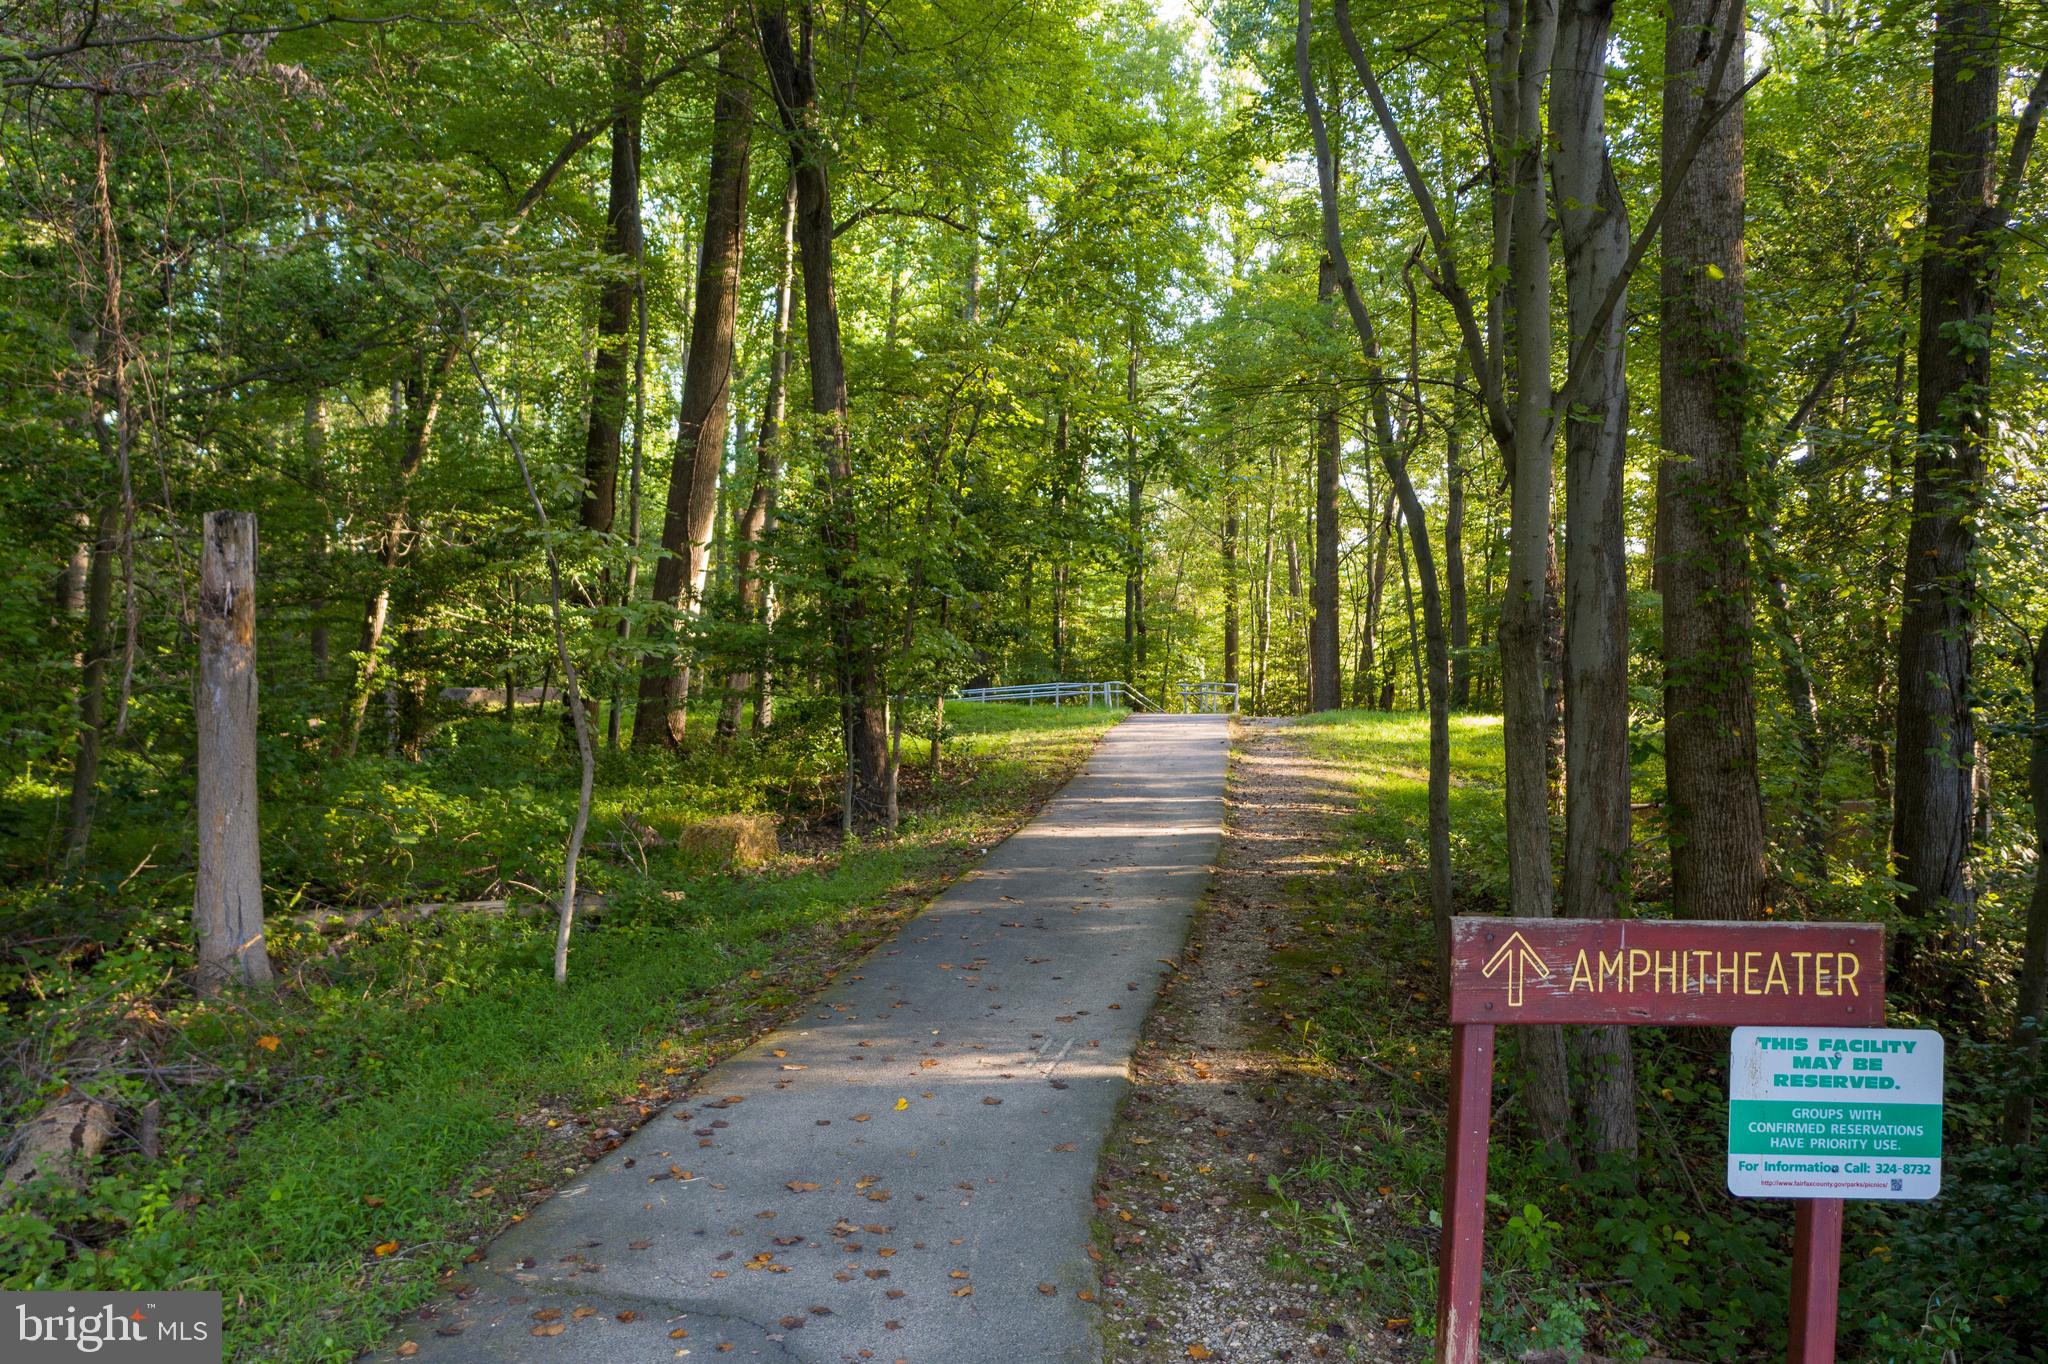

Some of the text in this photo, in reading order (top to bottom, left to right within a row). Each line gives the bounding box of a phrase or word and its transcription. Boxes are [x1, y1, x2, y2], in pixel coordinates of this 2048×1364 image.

[1569, 949, 1860, 997] AMPHITHEATER
[1758, 1037, 1917, 1054] THIS FACILITY
[1793, 1057, 1883, 1071] MAY BE
[1774, 1074, 1900, 1090] RESERVED.
[1792, 1108, 1882, 1120] GROUPS WITH
[1748, 1122, 1923, 1136] CONFIRMED RESERVATIONS
[1770, 1137, 1901, 1151] HAVE PRIORITY USE.
[1738, 1161, 1759, 1172] For
[1844, 1162, 1871, 1174] Call:
[1875, 1163, 1932, 1175] 324-8732
